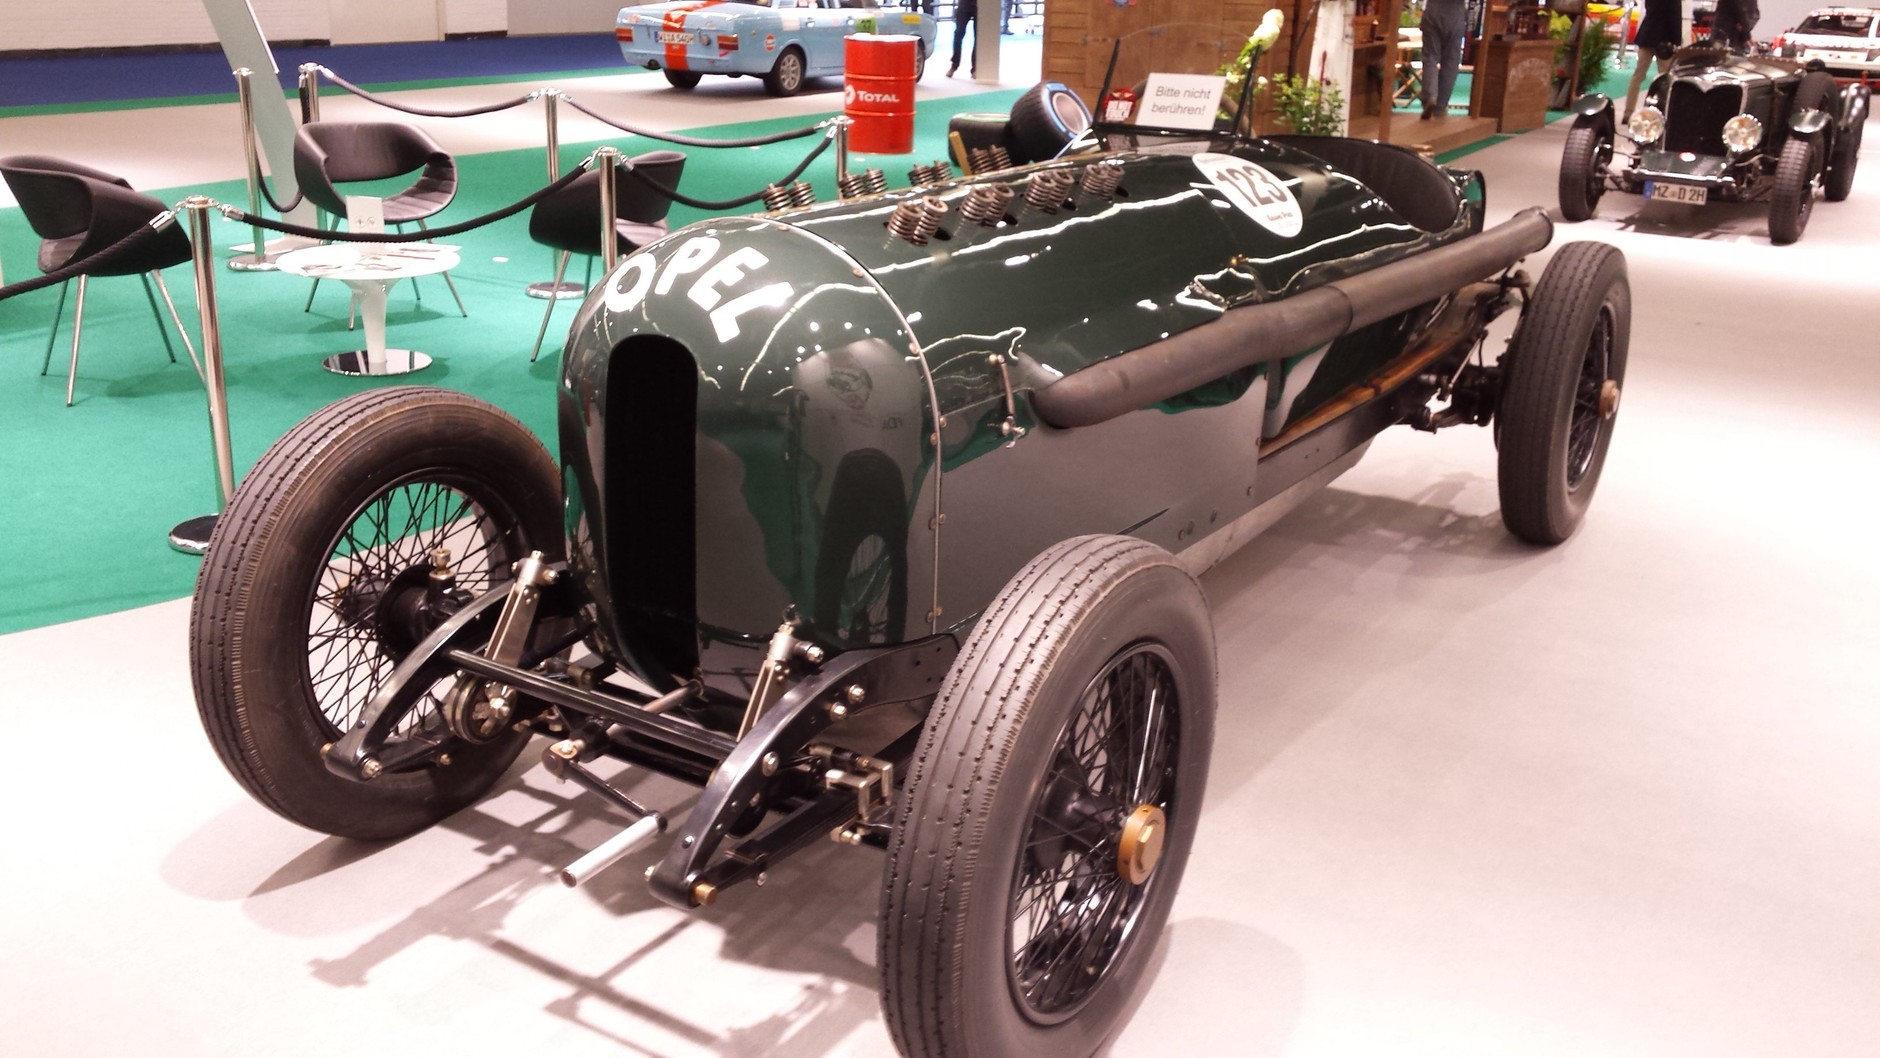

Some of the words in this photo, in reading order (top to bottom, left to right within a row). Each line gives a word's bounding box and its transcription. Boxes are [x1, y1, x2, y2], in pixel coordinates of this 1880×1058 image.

[857, 90, 900, 103] TOTAL
[1155, 86, 1180, 98] Bitte
[1183, 87, 1211, 99] nicht
[1151, 102, 1206, 116] berühren!
[1215, 165, 1288, 207] 123
[1652, 184, 1669, 198] MZ
[604, 236, 795, 344] OPEL
